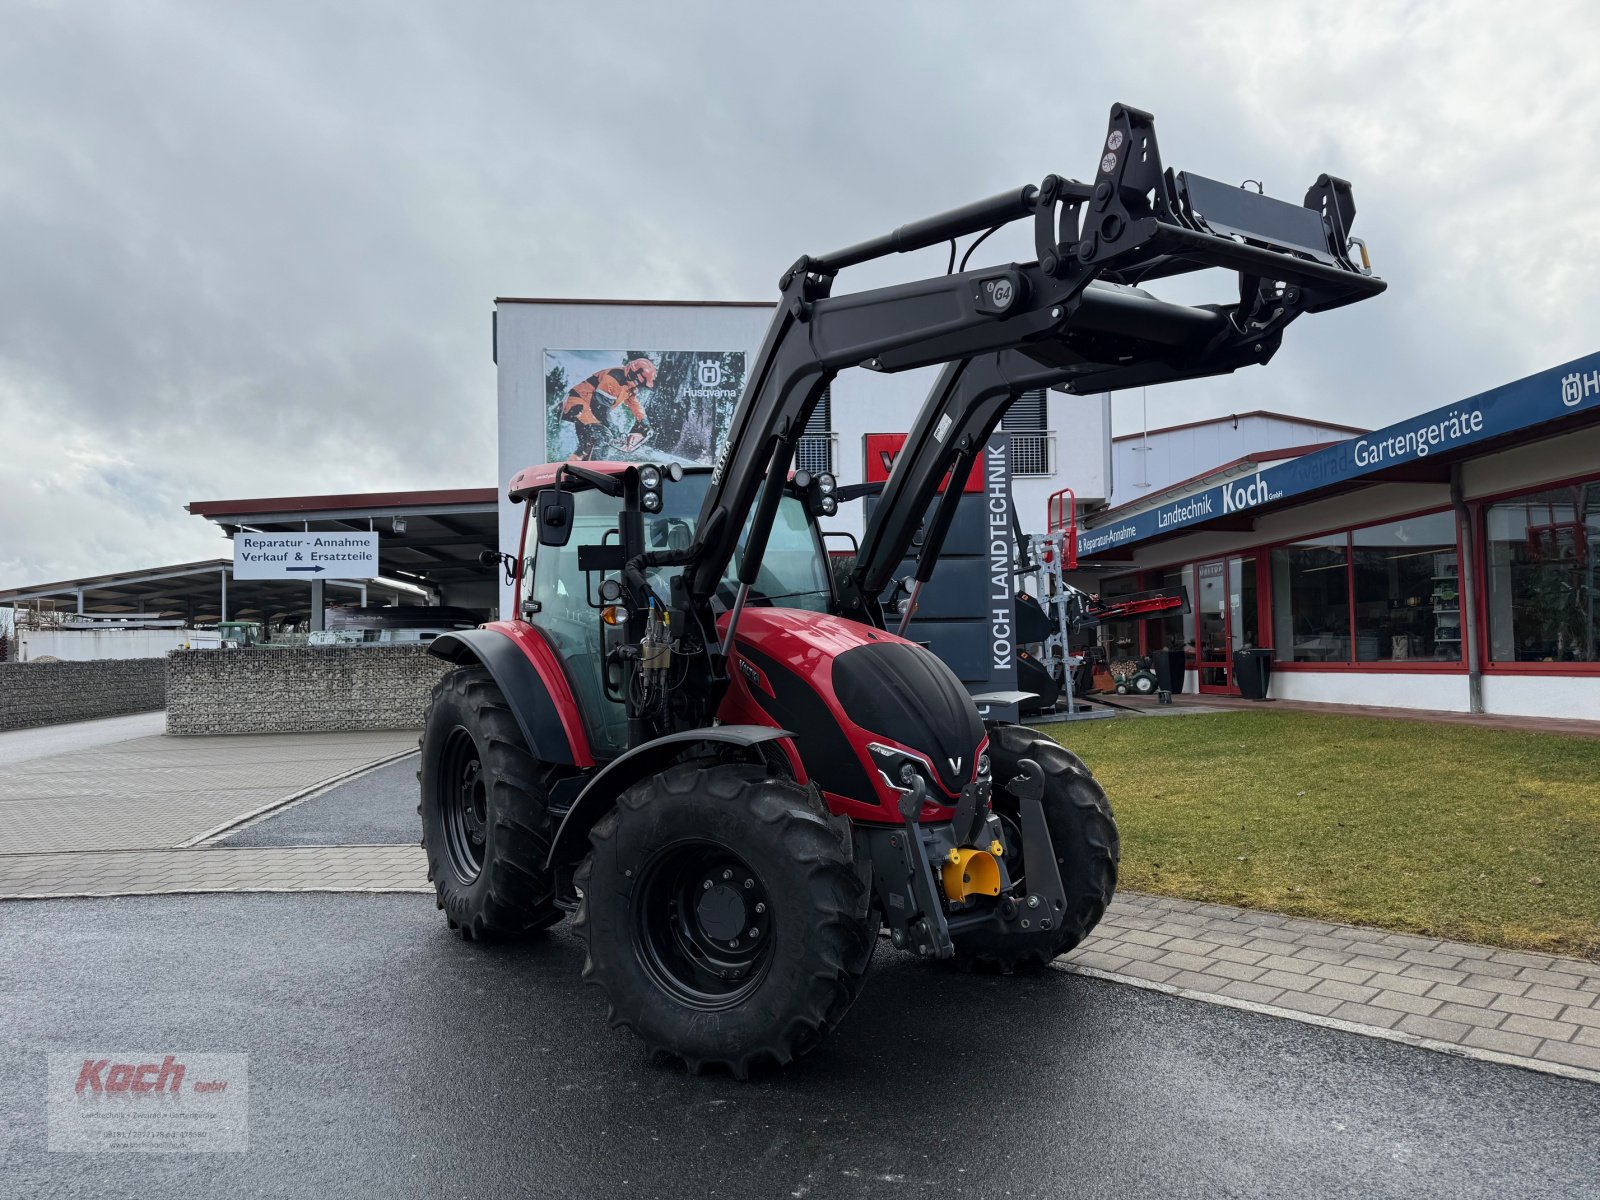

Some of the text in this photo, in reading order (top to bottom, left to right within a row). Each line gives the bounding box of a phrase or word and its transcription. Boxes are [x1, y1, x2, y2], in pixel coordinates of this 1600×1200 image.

[994, 286, 1011, 301] G4
[683, 387, 737, 399] Husqvarna
[711, 441, 734, 486] VALTRA
[1078, 542, 1083, 552] &
[1083, 524, 1137, 552] Reparatur-Annahme
[1158, 493, 1212, 528] Landtechnik
[1222, 473, 1269, 514] Koch
[1268, 490, 1283, 500] GmbH
[1354, 410, 1483, 467] Gartengeräte
[244, 538, 303, 550] Reparatur
[313, 537, 371, 547] Annahme
[241, 551, 373, 562] Verkauf & Ersatzteile
[988, 445, 1011, 669] KOCH LANDTECHNIK
